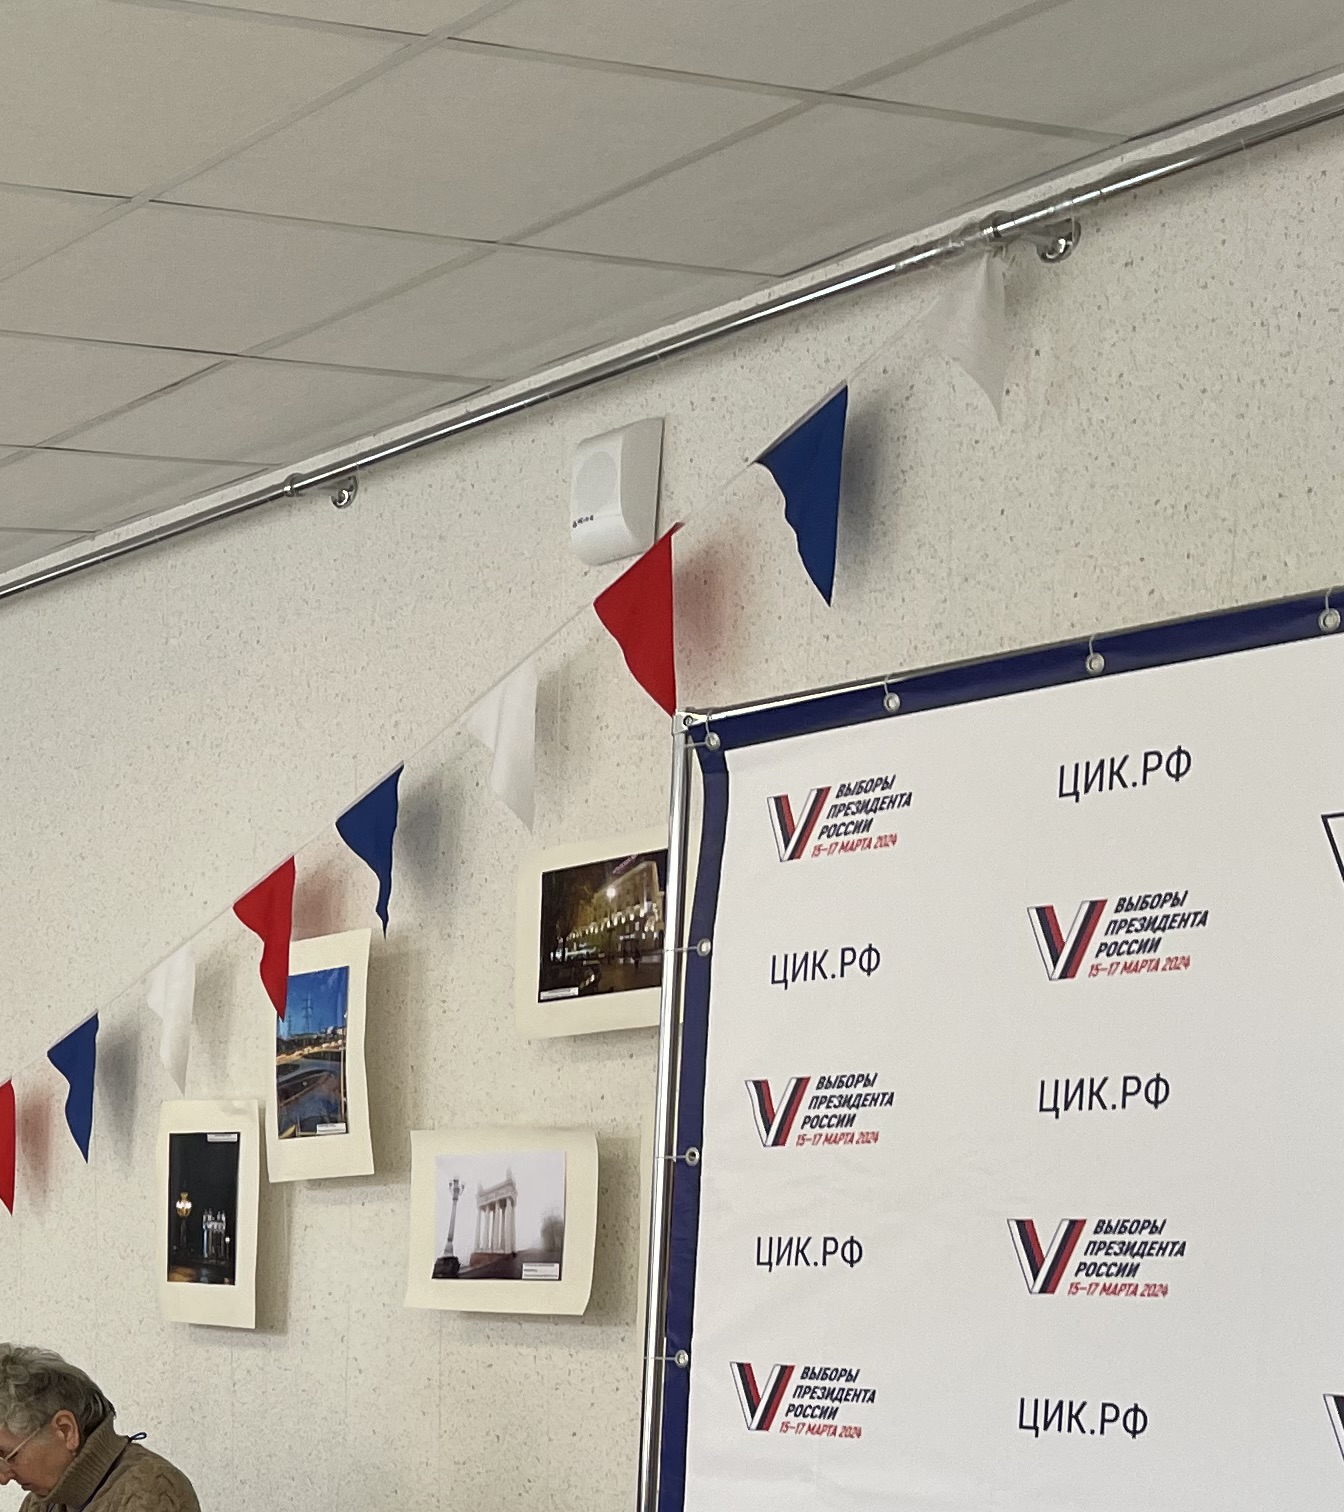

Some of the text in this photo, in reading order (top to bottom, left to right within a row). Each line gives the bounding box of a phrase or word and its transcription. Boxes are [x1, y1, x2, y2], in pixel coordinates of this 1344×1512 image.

[1059, 746, 1191, 802] ЦИК.РФ
[835, 774, 897, 799] ВЫБОРЫ
[826, 791, 913, 819] ПРЕЗИДЕНТА
[817, 817, 874, 840] РОССИИ
[838, 836, 873, 855] МАРТА
[873, 833, 898, 850] 2024
[1114, 889, 1189, 914] ВЫБОРЫ
[1104, 909, 1209, 937] ПРЕЗИДЕНТА
[1095, 937, 1162, 959] РОССИИ
[772, 944, 880, 990] ЦИК.РФ
[1120, 958, 1160, 976] МАРТА
[1161, 955, 1191, 972] 2024
[815, 1072, 878, 1091] ВЫБОРЫ
[808, 1091, 895, 1111] ПРЕЗИДЕНТА
[1039, 1073, 1169, 1119] ЦИК.РФ
[800, 1113, 857, 1130] РОССИИ
[822, 1131, 855, 1146] МАРТА
[855, 1130, 880, 1145] 2024
[1093, 1218, 1167, 1235] ВЫБОРЫ
[757, 1236, 862, 1272] ЦИК.РФ
[1084, 1240, 1187, 1259] ПРЕЗИДЕНТА
[1074, 1261, 1141, 1278] РОССИИ
[1099, 1282, 1138, 1297] МАРТА
[1139, 1283, 1169, 1298] 2024
[800, 1365, 861, 1383] ВЫБОРЫ
[792, 1384, 877, 1404] ПРЕЗИДЕНТА
[784, 1403, 840, 1421] РОССИИ
[1019, 1398, 1147, 1438] ЦИК.РФ
[805, 1423, 837, 1437] МАРТА
[838, 1425, 863, 1439] 2024
